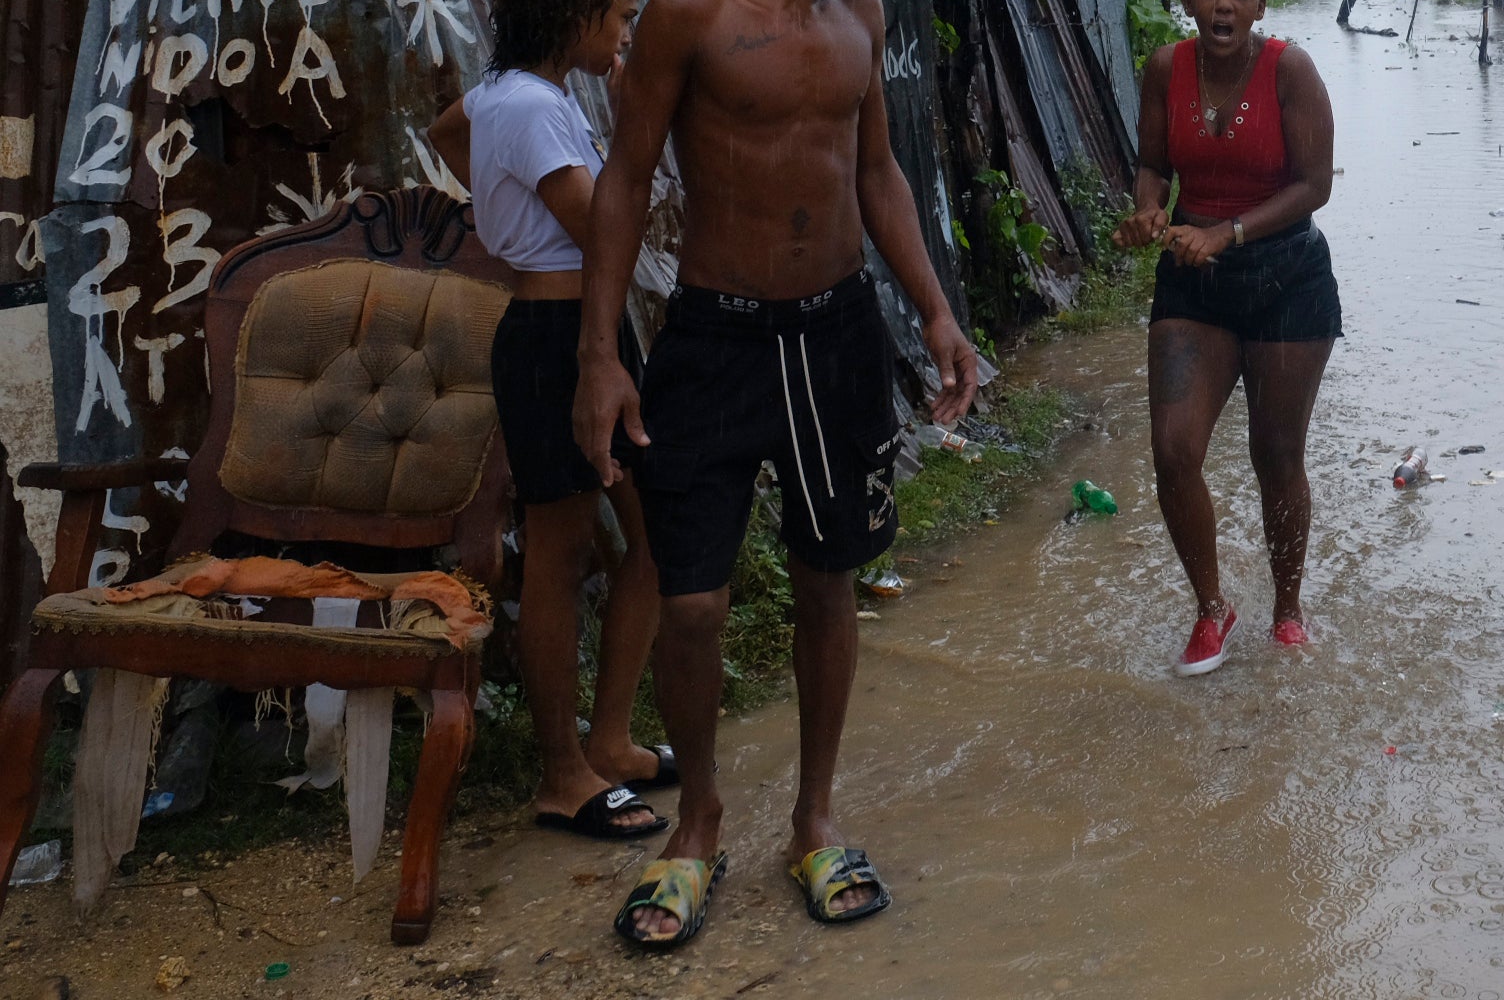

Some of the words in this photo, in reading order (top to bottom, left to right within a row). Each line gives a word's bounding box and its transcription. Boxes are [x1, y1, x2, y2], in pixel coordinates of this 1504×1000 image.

[278, 27, 347, 99] A
[69, 102, 198, 185] 20
[68, 208, 222, 316] 23
[717, 294, 760, 310] LEO
[799, 289, 834, 308] LEO
[877, 440, 891, 455] OFF
[608, 789, 631, 802] NIKE
